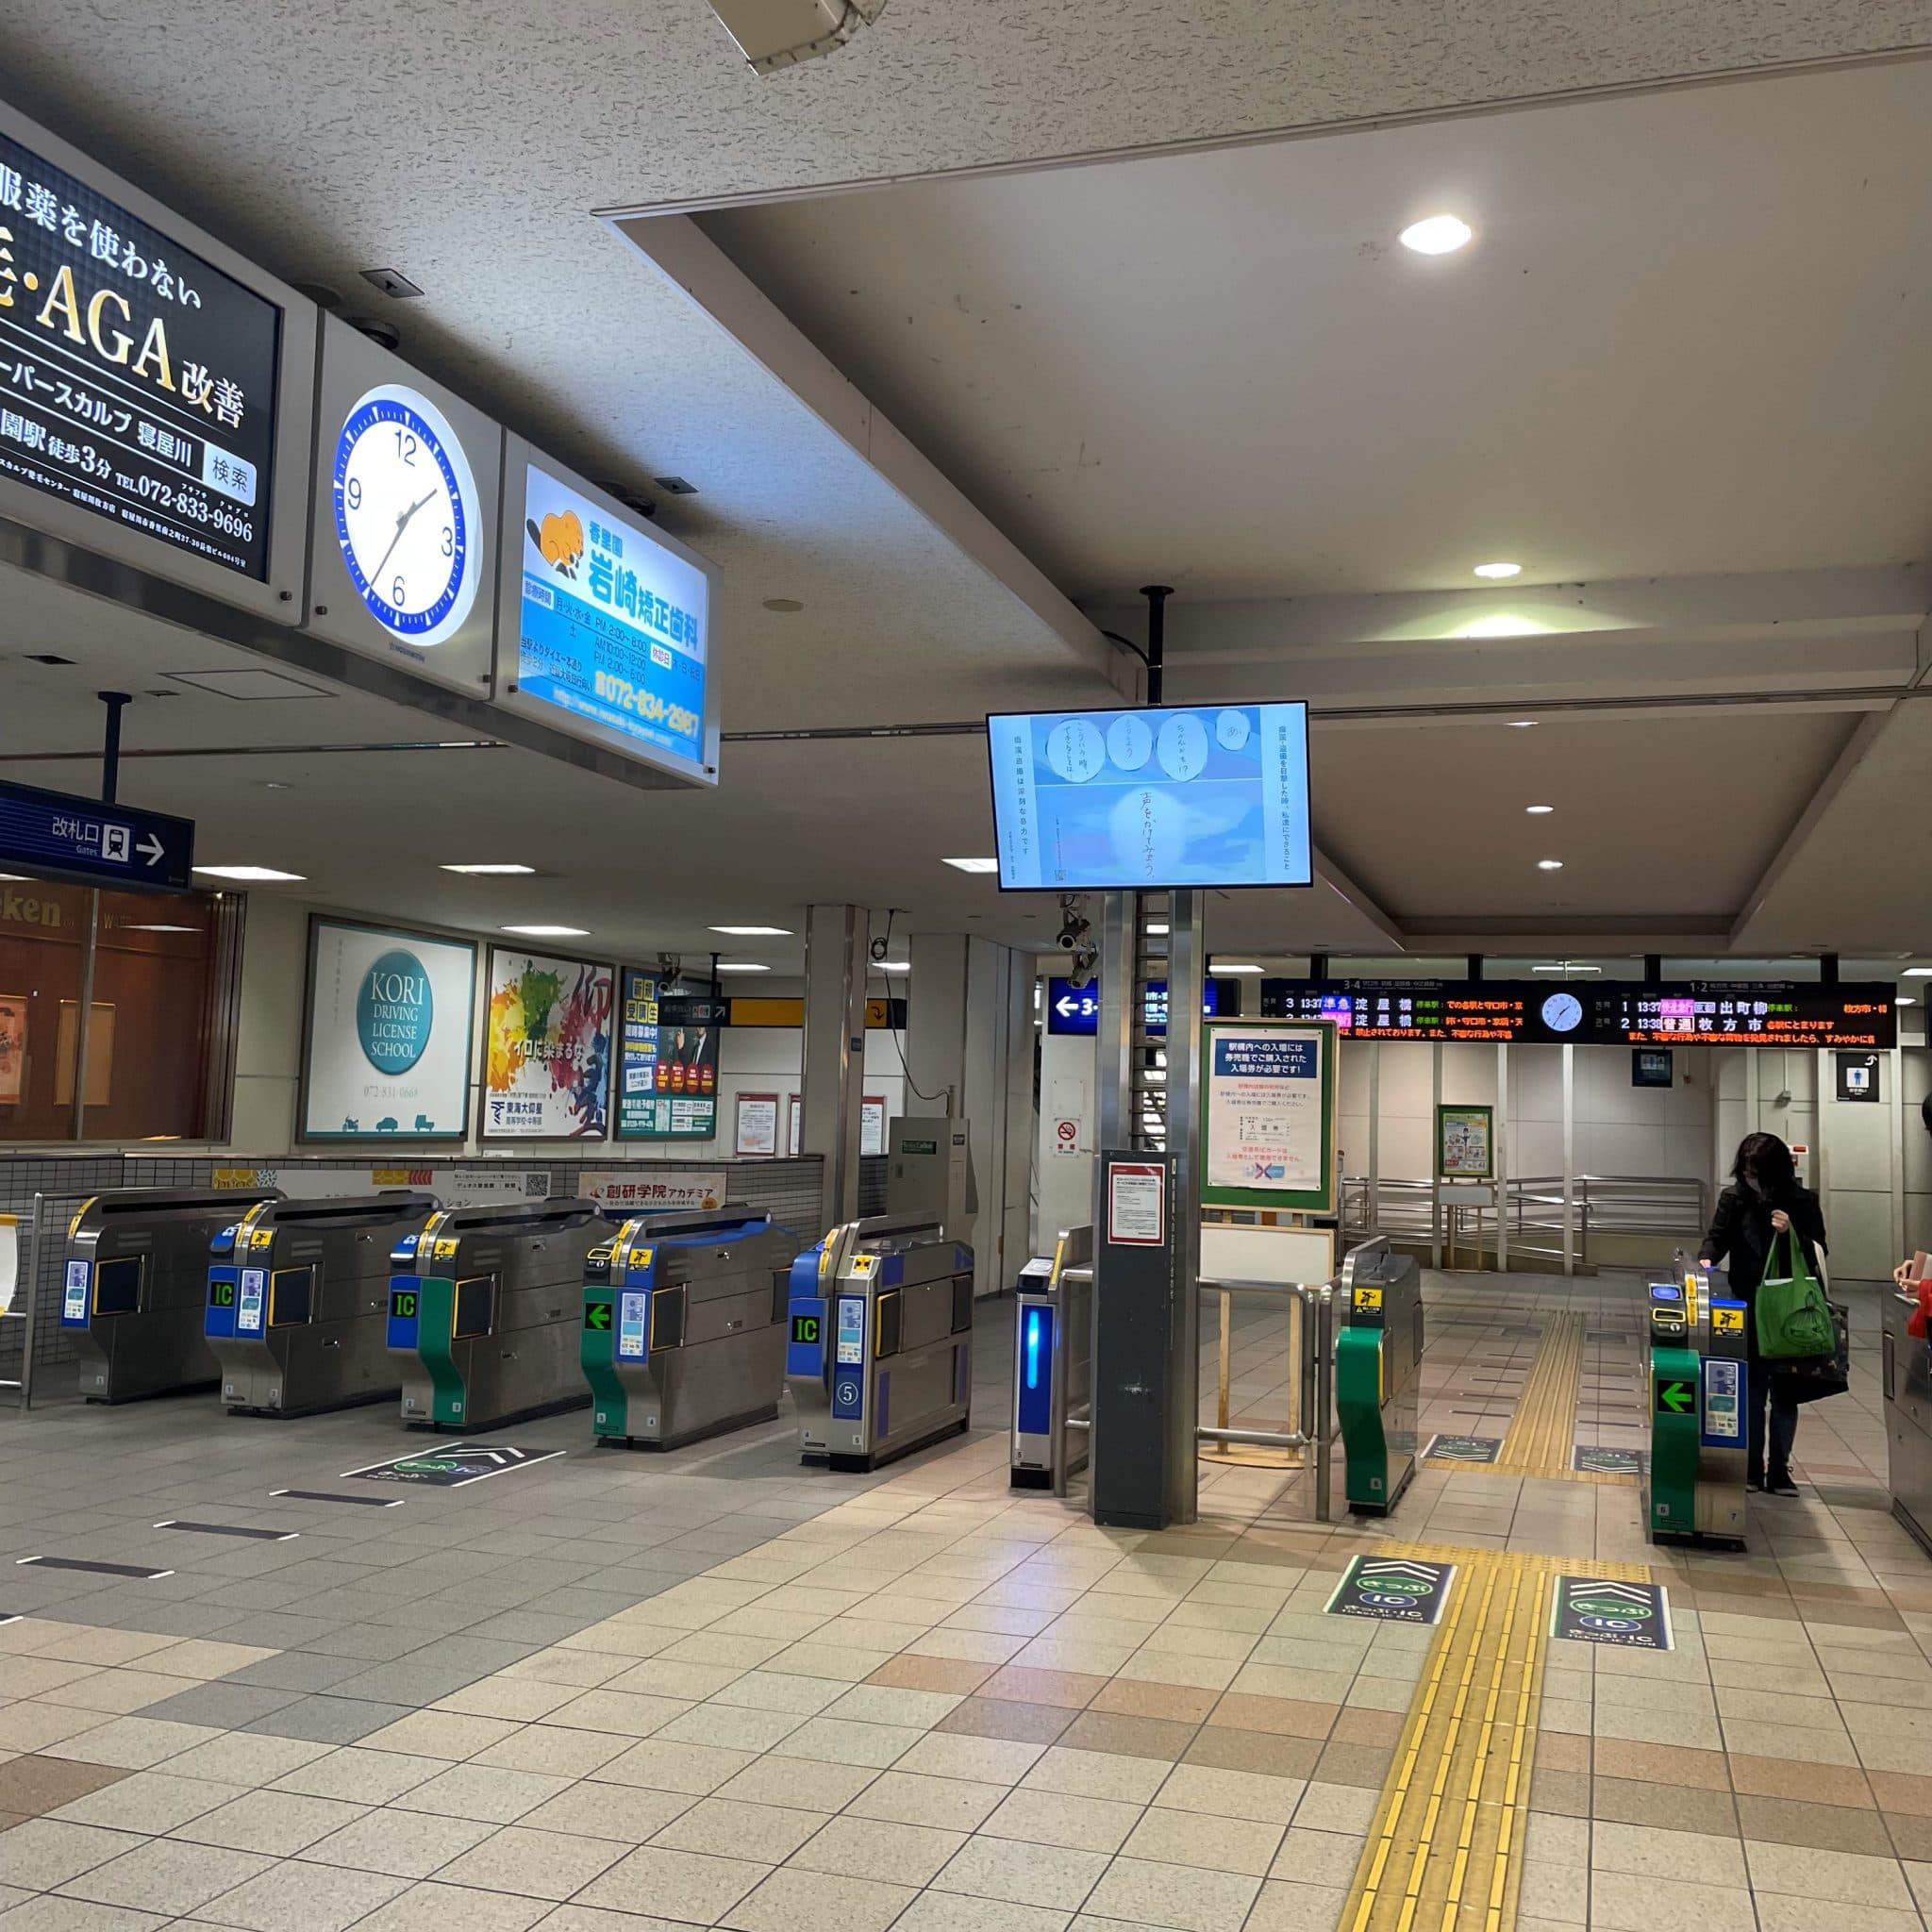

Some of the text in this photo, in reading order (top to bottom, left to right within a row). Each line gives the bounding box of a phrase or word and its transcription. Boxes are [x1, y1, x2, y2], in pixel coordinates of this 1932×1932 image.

[394, 429, 417, 468] 12
[348, 477, 362, 510] 9
[441, 526, 454, 558] 3
[392, 575, 406, 607] 6
[589, 549, 698, 651] 岩崎矯正歯科
[52, 817, 99, 843] 改札口
[75, 844, 98, 856] Gates
[0, 887, 61, 927] ken
[371, 972, 425, 1006] KORI
[1286, 998, 1294, 1008] 3
[1622, 1002, 1628, 1012] 1
[1720, 1000, 1768, 1015] 出町柳
[374, 1004, 418, 1023] DRIVING
[373, 1023, 418, 1040] LICENSE
[1621, 1019, 1630, 1029] 2
[1663, 1018, 1691, 1030] 普通
[1698, 1017, 1762, 1031] 枚方市
[371, 1041, 417, 1058] SCHOOL
[1228, 1042, 1304, 1053] 駅構内への入場には
[1224, 1053, 1307, 1063] 券売機でご購入された
[607, 1184, 714, 1199] 創研学院アカデミア
[215, 1285, 233, 1306] IC
[396, 1294, 415, 1316] IC
[796, 1319, 817, 1341] IC
[1373, 1594, 1406, 1605] IC
[1595, 1618, 1629, 1628] IC
